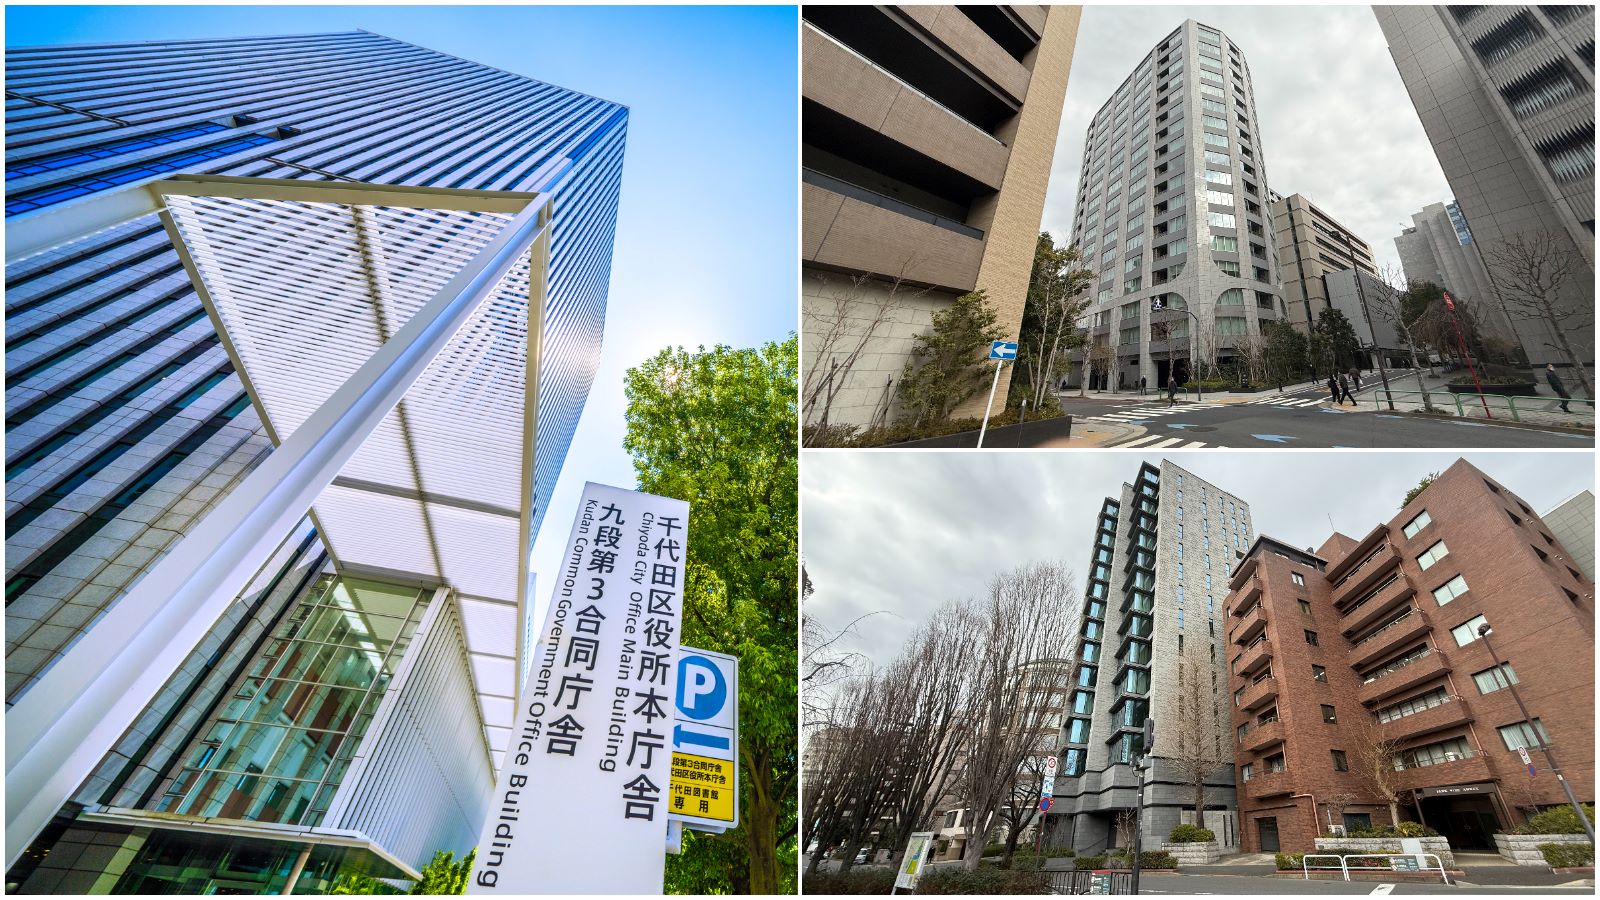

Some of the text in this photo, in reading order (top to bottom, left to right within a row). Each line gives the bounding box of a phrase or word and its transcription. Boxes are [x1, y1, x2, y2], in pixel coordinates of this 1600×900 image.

[477, 499, 598, 887] Kudan Common Government Office Building
[546, 503, 625, 757] 九段第3合同庁舎
[599, 512, 654, 772] Chiyoda City Office Main Building
[623, 516, 682, 821] 千代田区役所本庁舎
[683, 663, 716, 709] P
